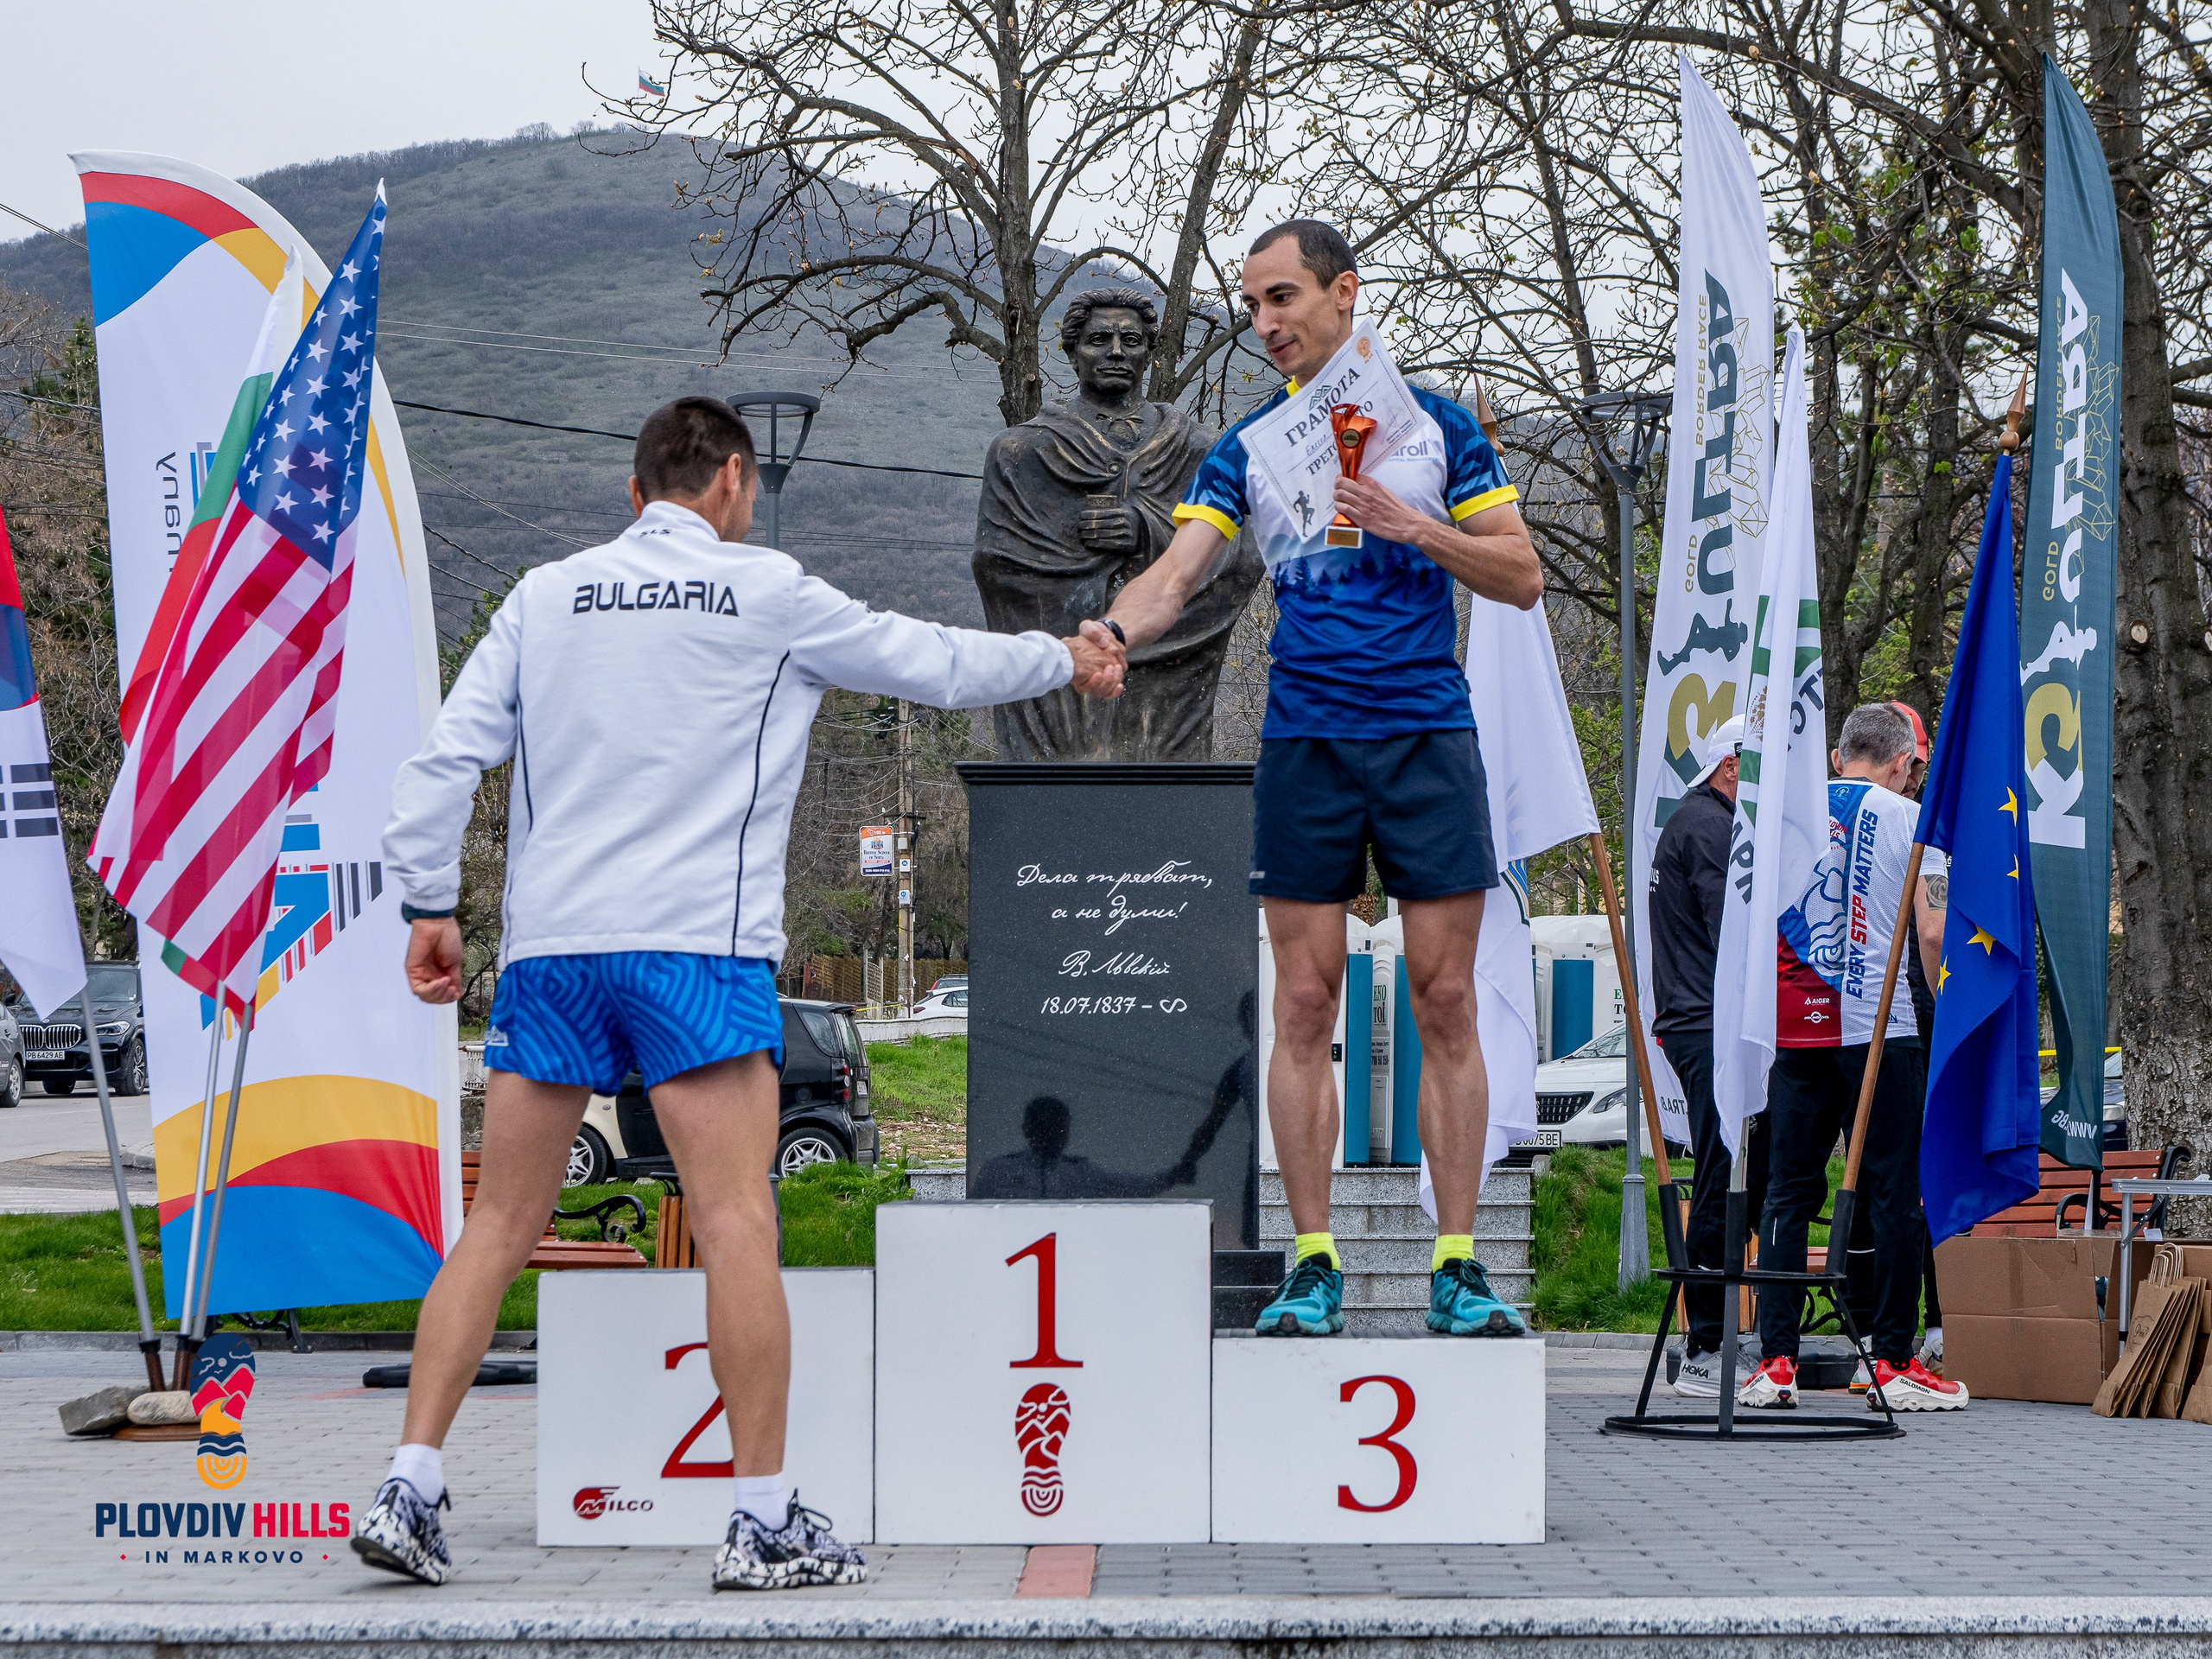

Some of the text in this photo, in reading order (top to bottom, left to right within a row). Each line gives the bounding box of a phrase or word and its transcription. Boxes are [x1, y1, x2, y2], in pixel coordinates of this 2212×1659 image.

[1284, 367, 1361, 448] ГРАМОТА
[573, 581, 740, 617] BULGARIA
[1017, 863, 1079, 887] Дела
[1052, 895, 1188, 935] а не думи!
[1846, 808, 1878, 1000] EVERY STEP MATTERS
[1040, 996, 1137, 1014] 18.07.1837
[1546, 1134, 1558, 1145] BE
[1005, 1231, 1084, 1369] 1
[1681, 1363, 1709, 1379] HOKA
[1899, 1378, 1930, 1394] SALOMON
[1338, 1375, 1418, 1512] 3
